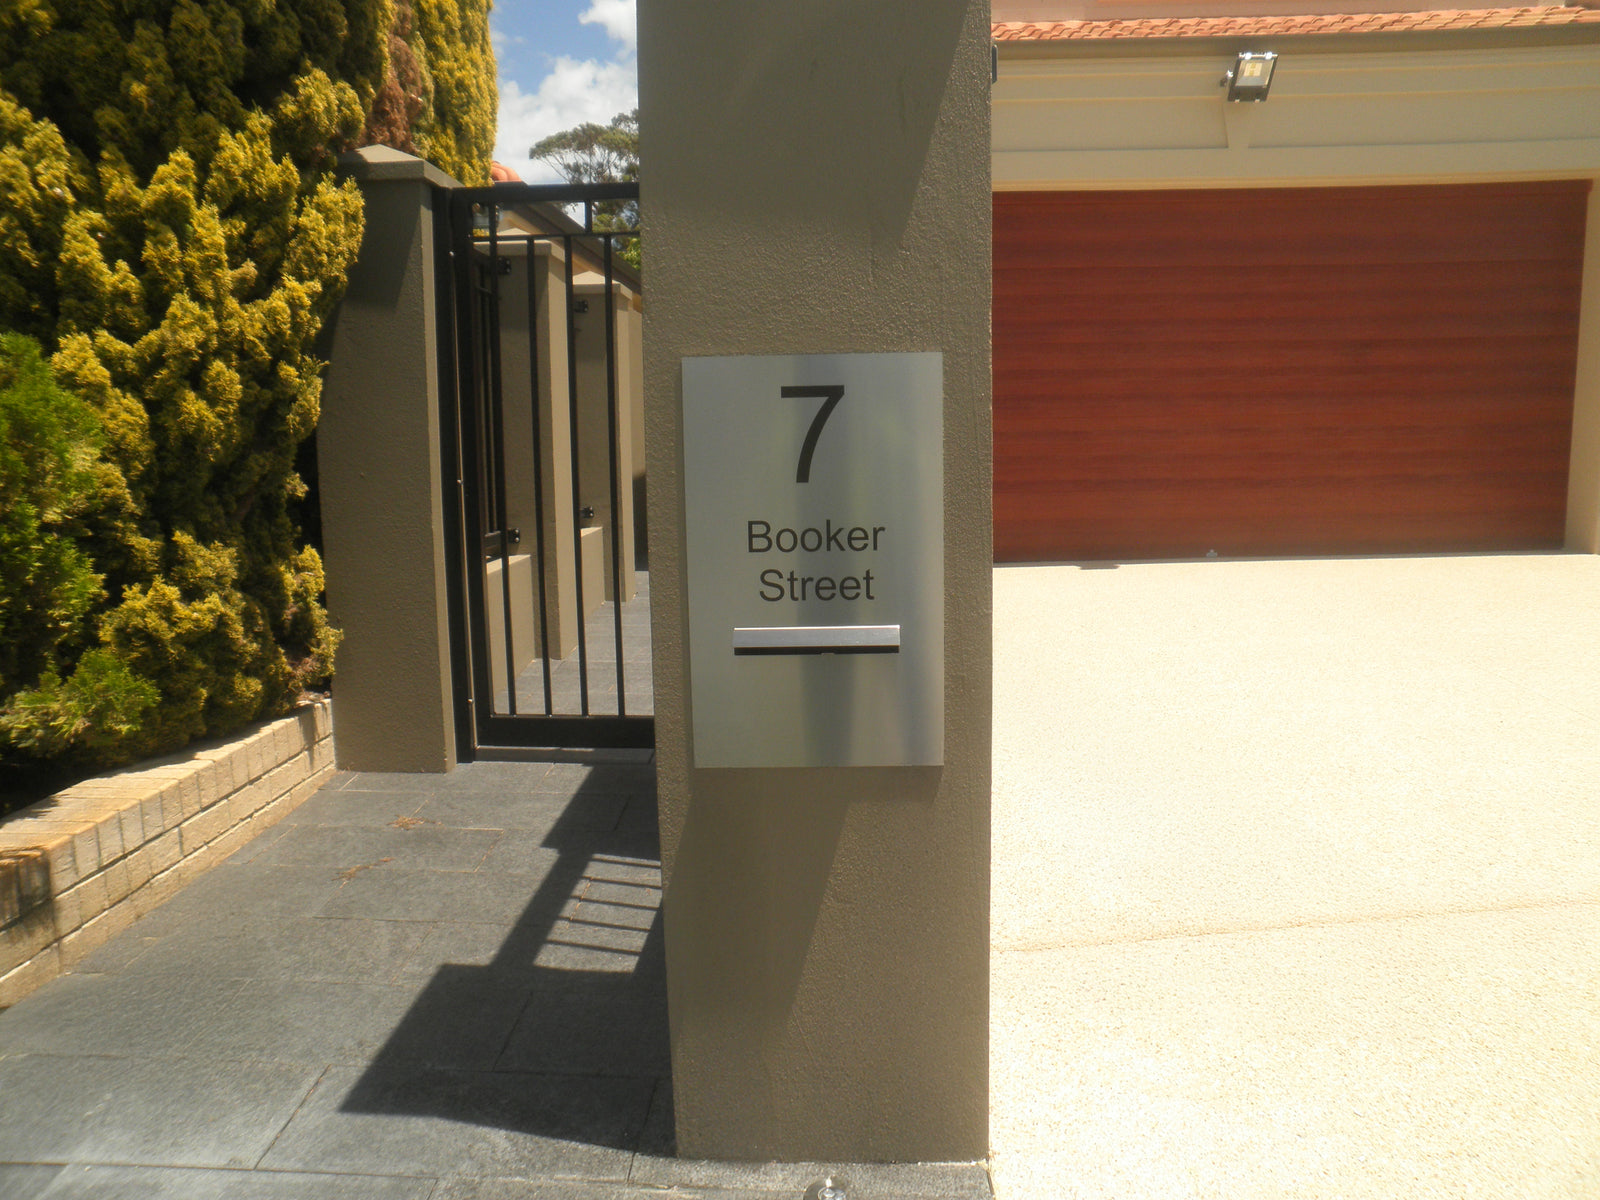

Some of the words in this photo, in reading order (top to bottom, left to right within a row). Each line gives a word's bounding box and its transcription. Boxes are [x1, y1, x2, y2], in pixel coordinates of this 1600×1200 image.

[780, 385, 845, 483] 7
[747, 519, 886, 553] Booker
[759, 568, 875, 602] Street
